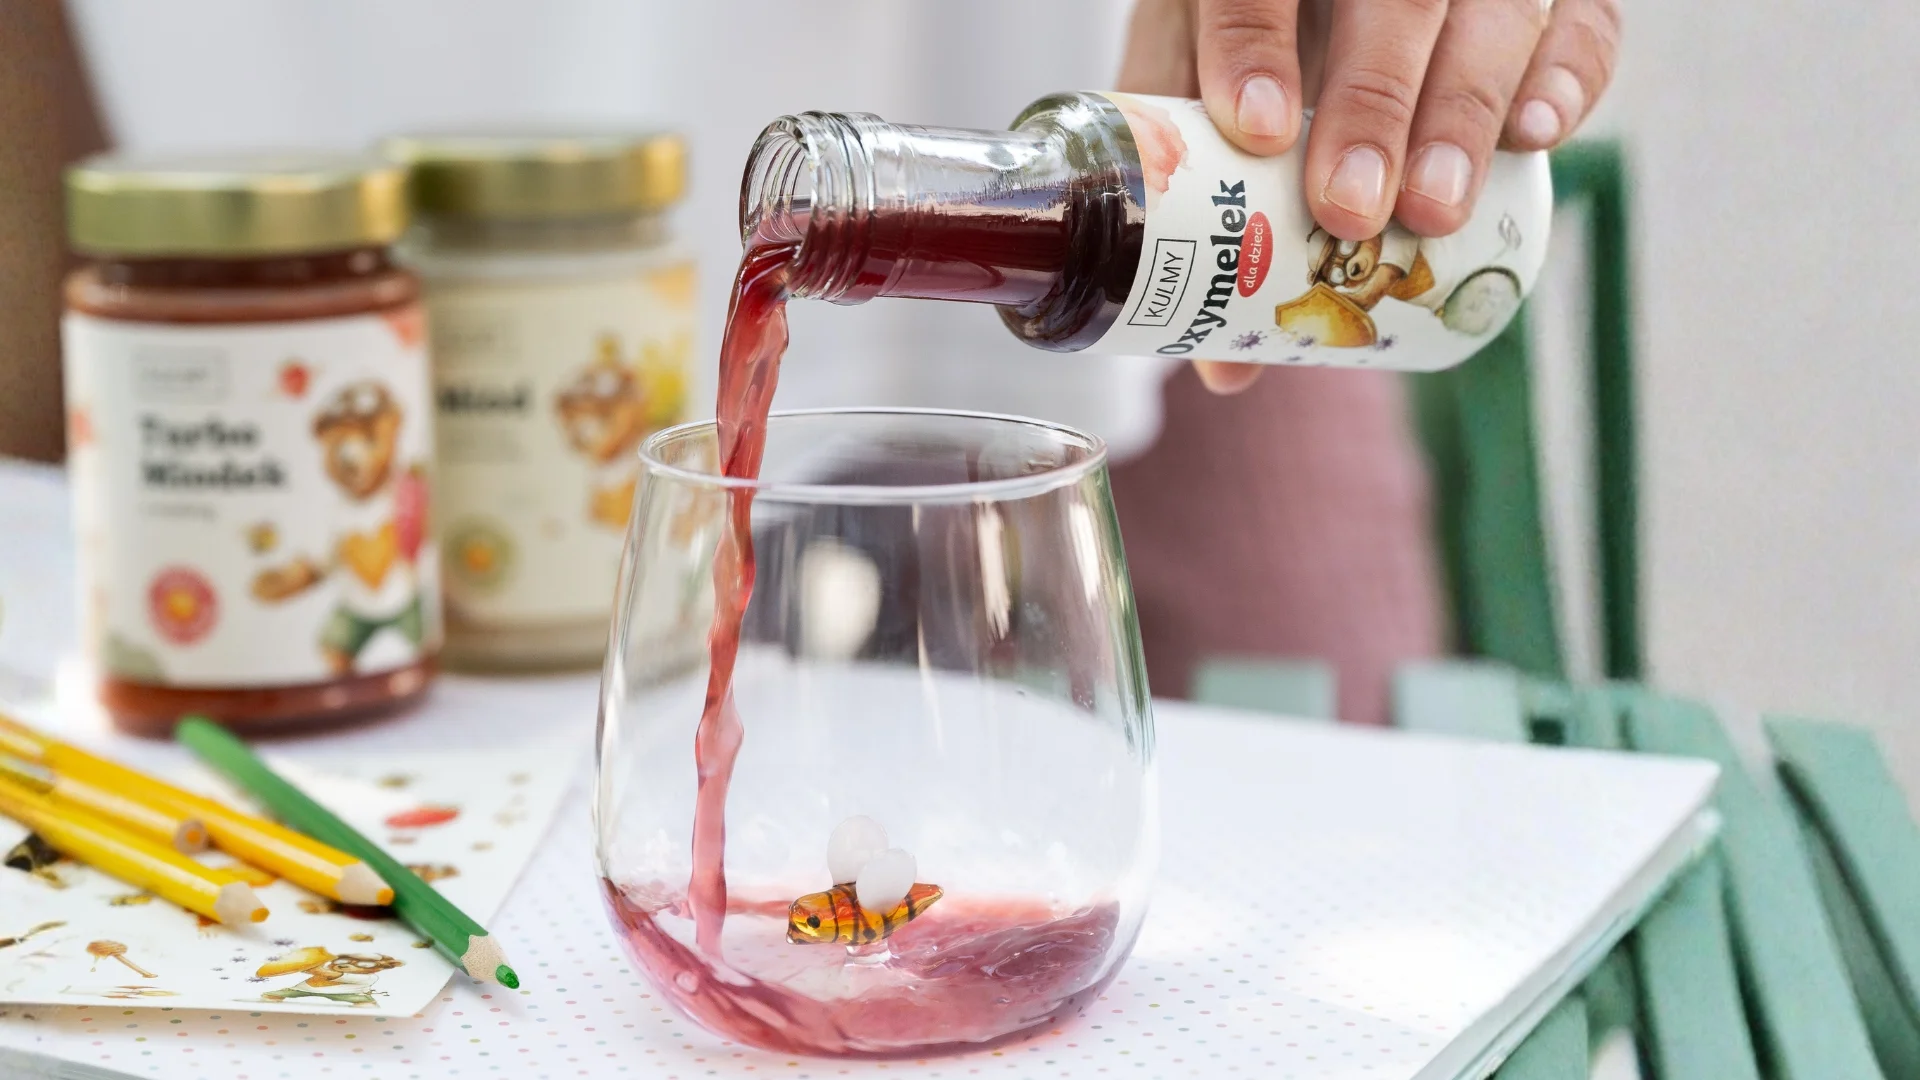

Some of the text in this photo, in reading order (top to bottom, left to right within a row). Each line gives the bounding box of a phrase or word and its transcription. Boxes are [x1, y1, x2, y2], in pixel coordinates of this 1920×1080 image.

[1143, 251, 1184, 318] KULMY
[1156, 179, 1247, 355] Oxymelek
[1243, 222, 1264, 288] dla dzieci
